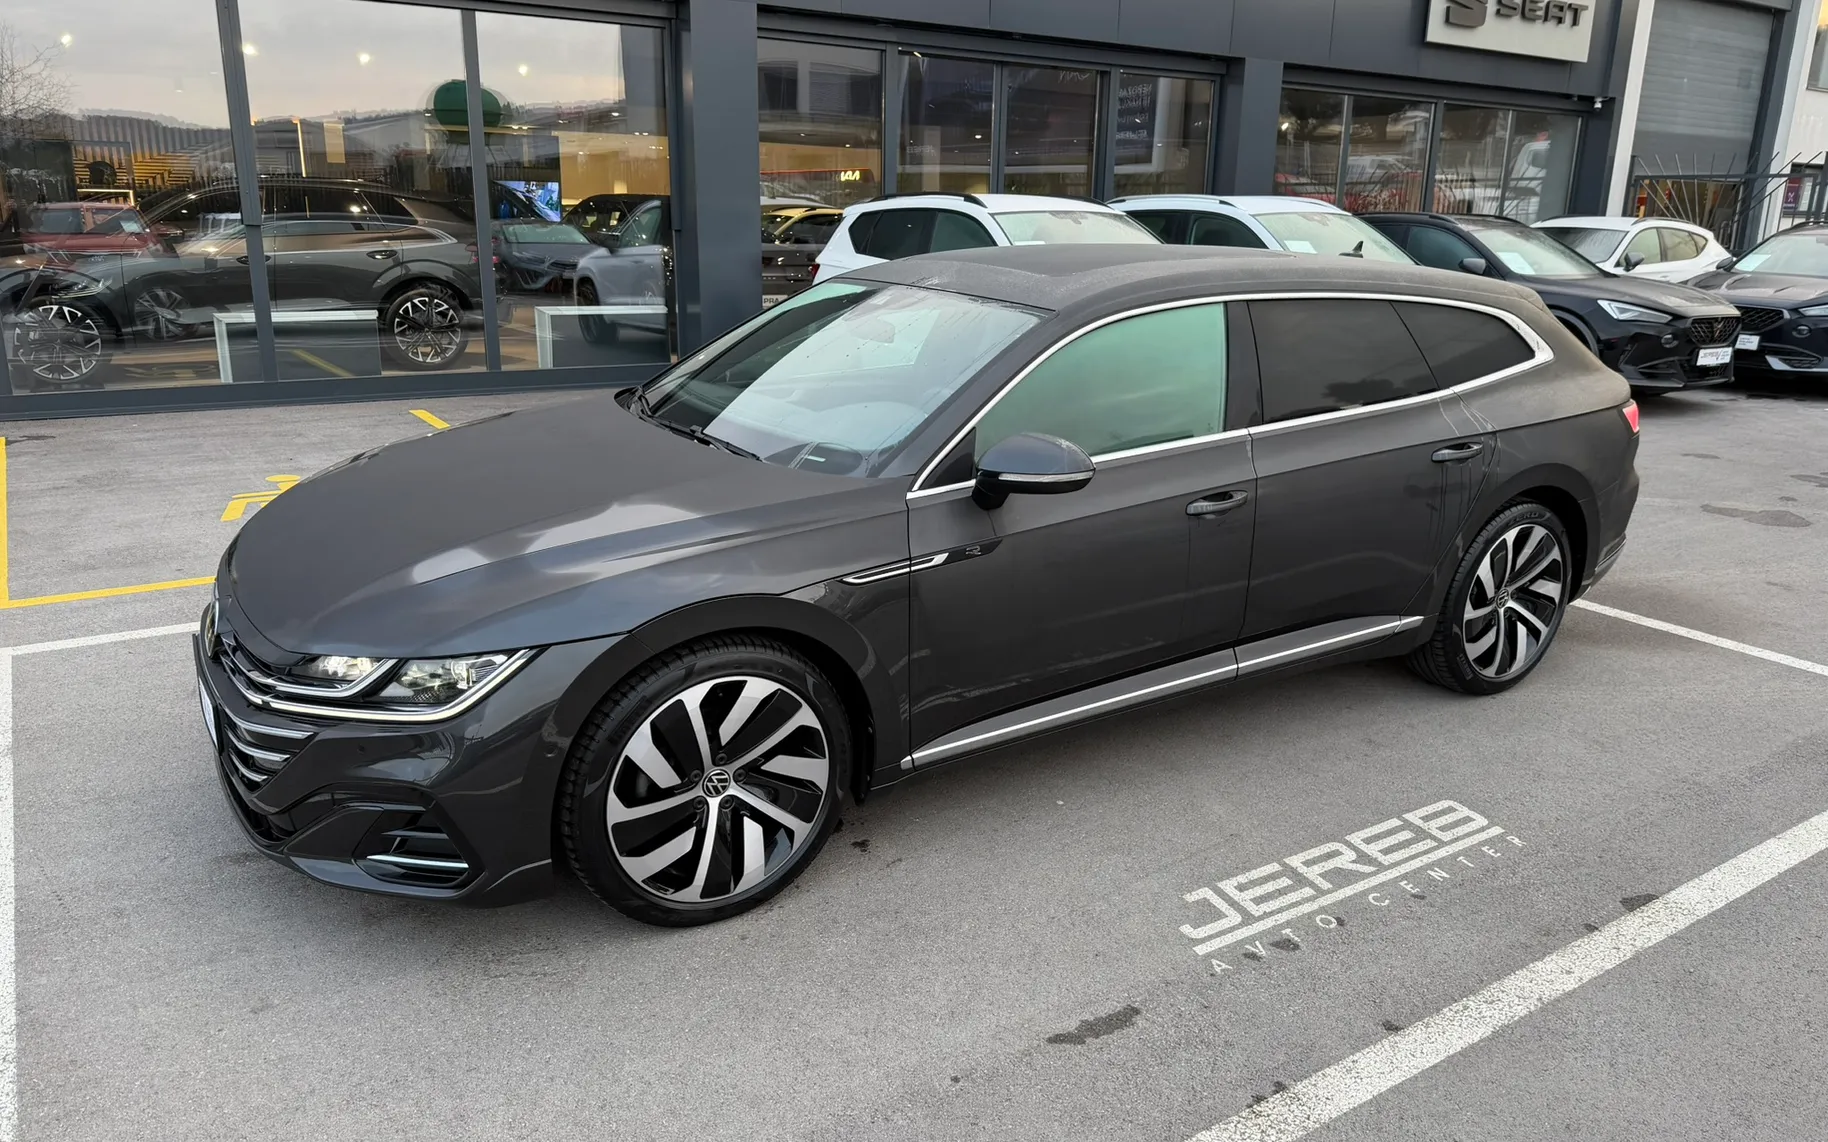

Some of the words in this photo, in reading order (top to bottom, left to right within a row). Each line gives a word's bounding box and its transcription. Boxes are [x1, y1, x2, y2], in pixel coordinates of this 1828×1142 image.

[1496, 0, 1588, 27] SEAT
[1179, 799, 1489, 939] JEREB
[1209, 914, 1338, 975] AVTO
[1367, 835, 1527, 906] CENTER
